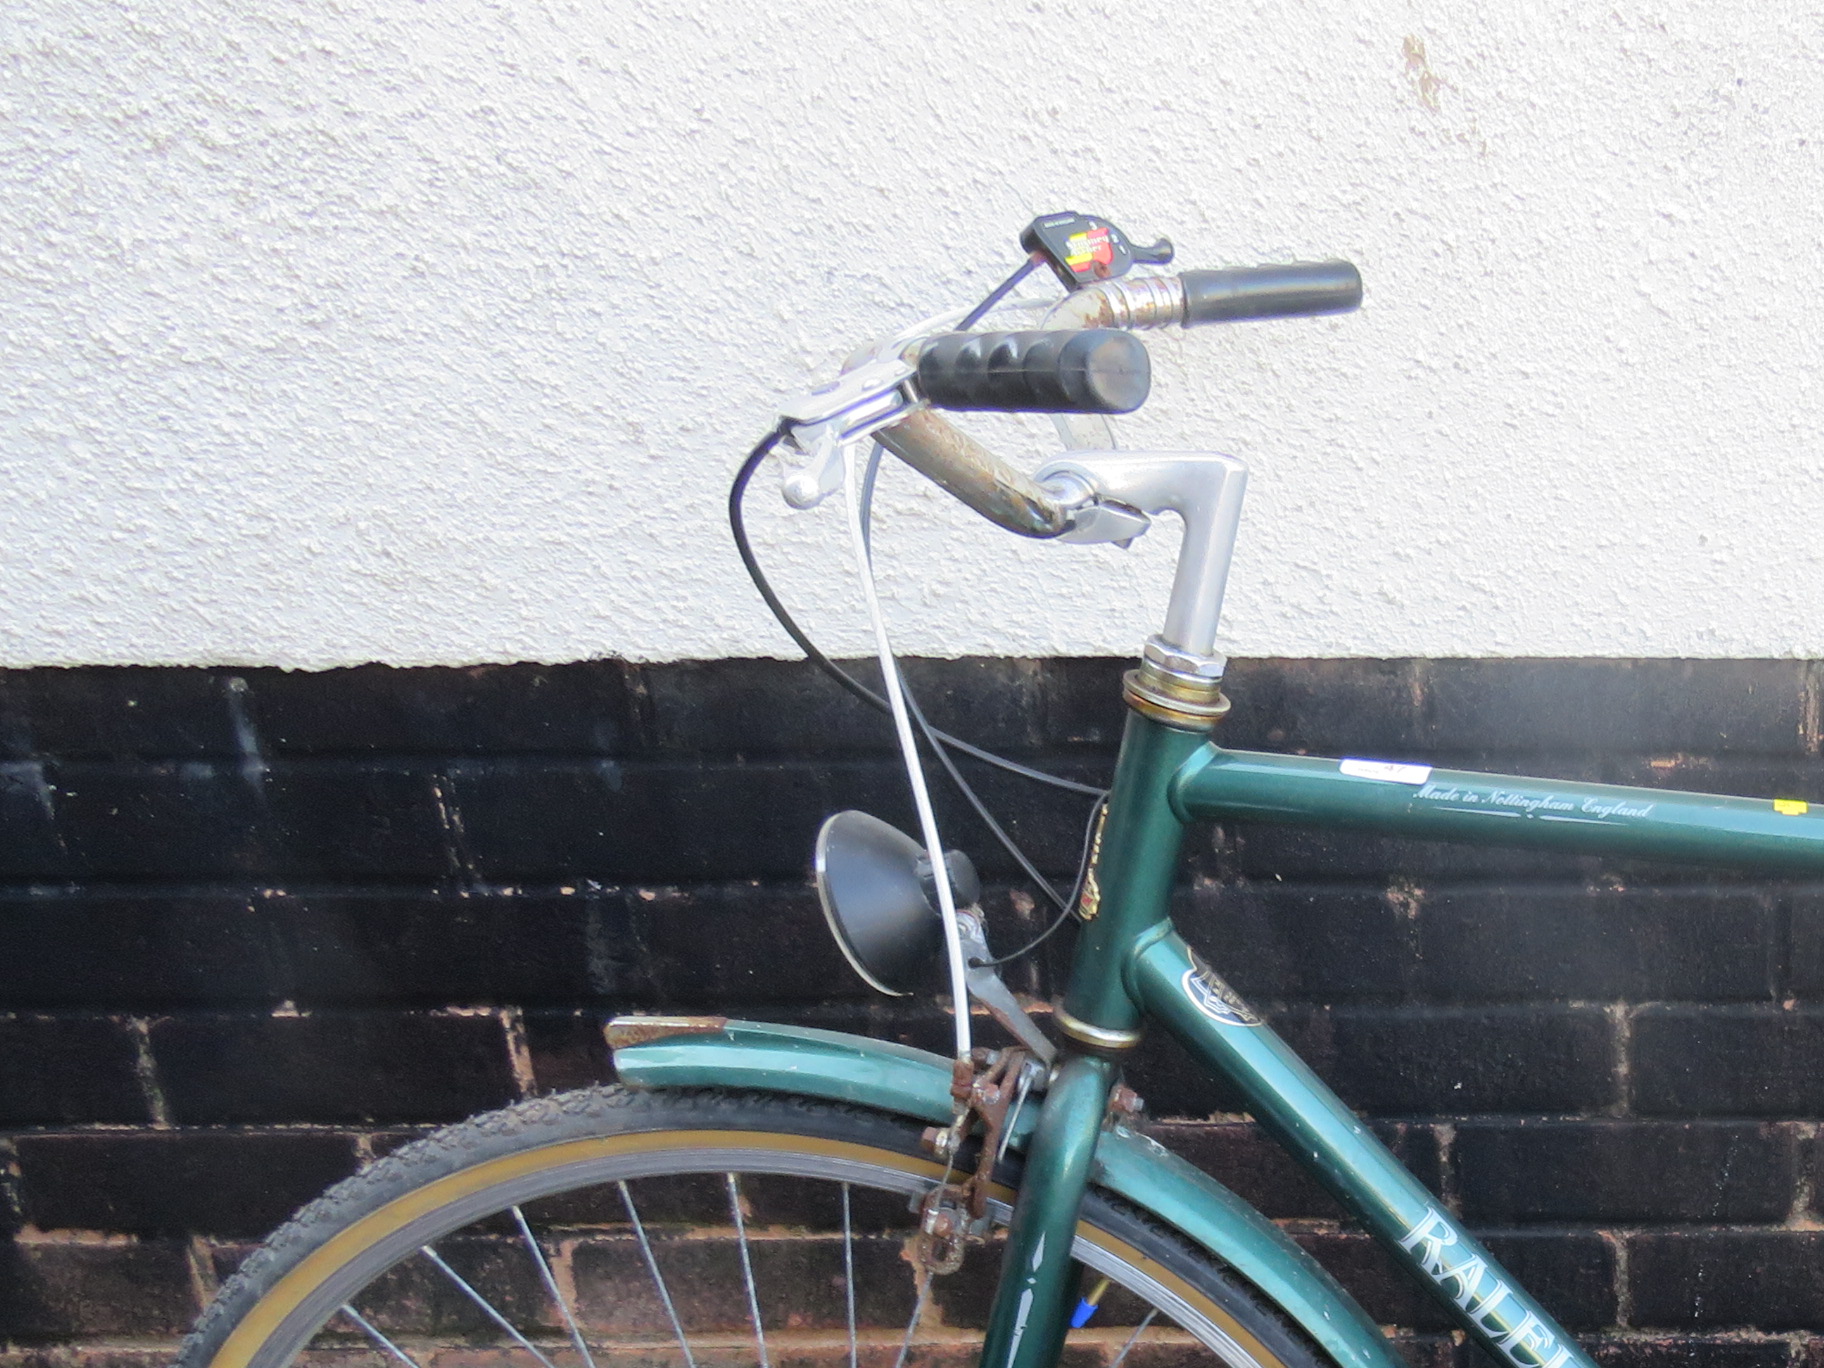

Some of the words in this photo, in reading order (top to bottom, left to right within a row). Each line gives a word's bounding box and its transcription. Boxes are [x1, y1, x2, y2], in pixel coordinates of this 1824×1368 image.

[1412, 784, 1459, 800] Made
[1462, 790, 1478, 803] in
[1481, 789, 1575, 812] Nottingham
[1581, 796, 1654, 819] England
